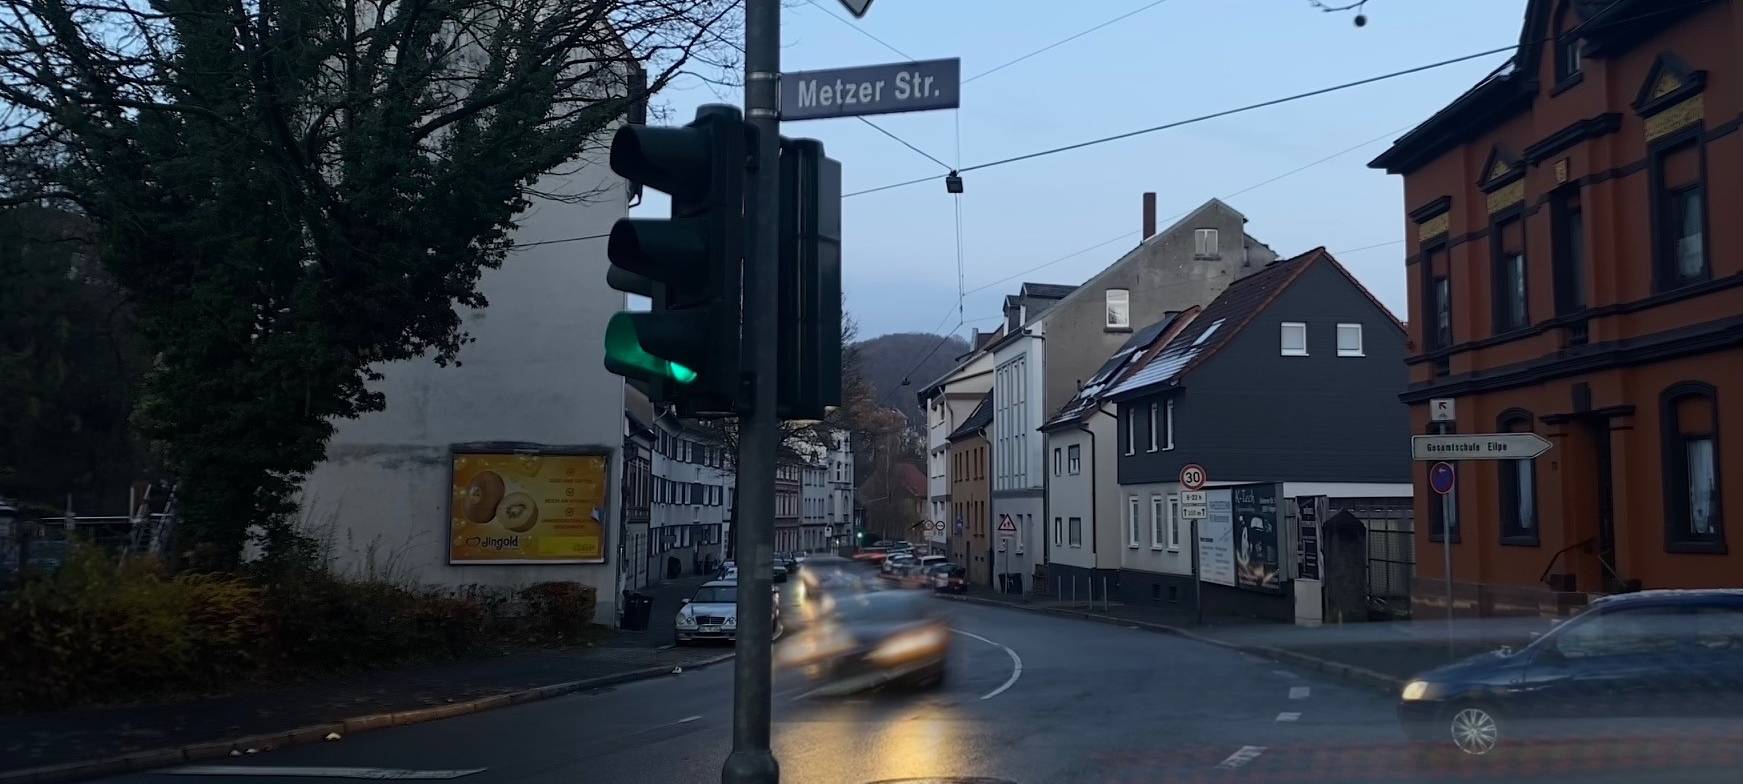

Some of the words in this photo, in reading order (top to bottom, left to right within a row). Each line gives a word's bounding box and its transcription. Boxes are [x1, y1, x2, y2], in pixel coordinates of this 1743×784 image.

[798, 79, 886, 108] Metzer
[895, 71, 940, 100] Str.
[1427, 443, 1480, 452] Gesamtschule
[1488, 442, 1507, 452] Eilpe
[1185, 472, 1200, 483] 30
